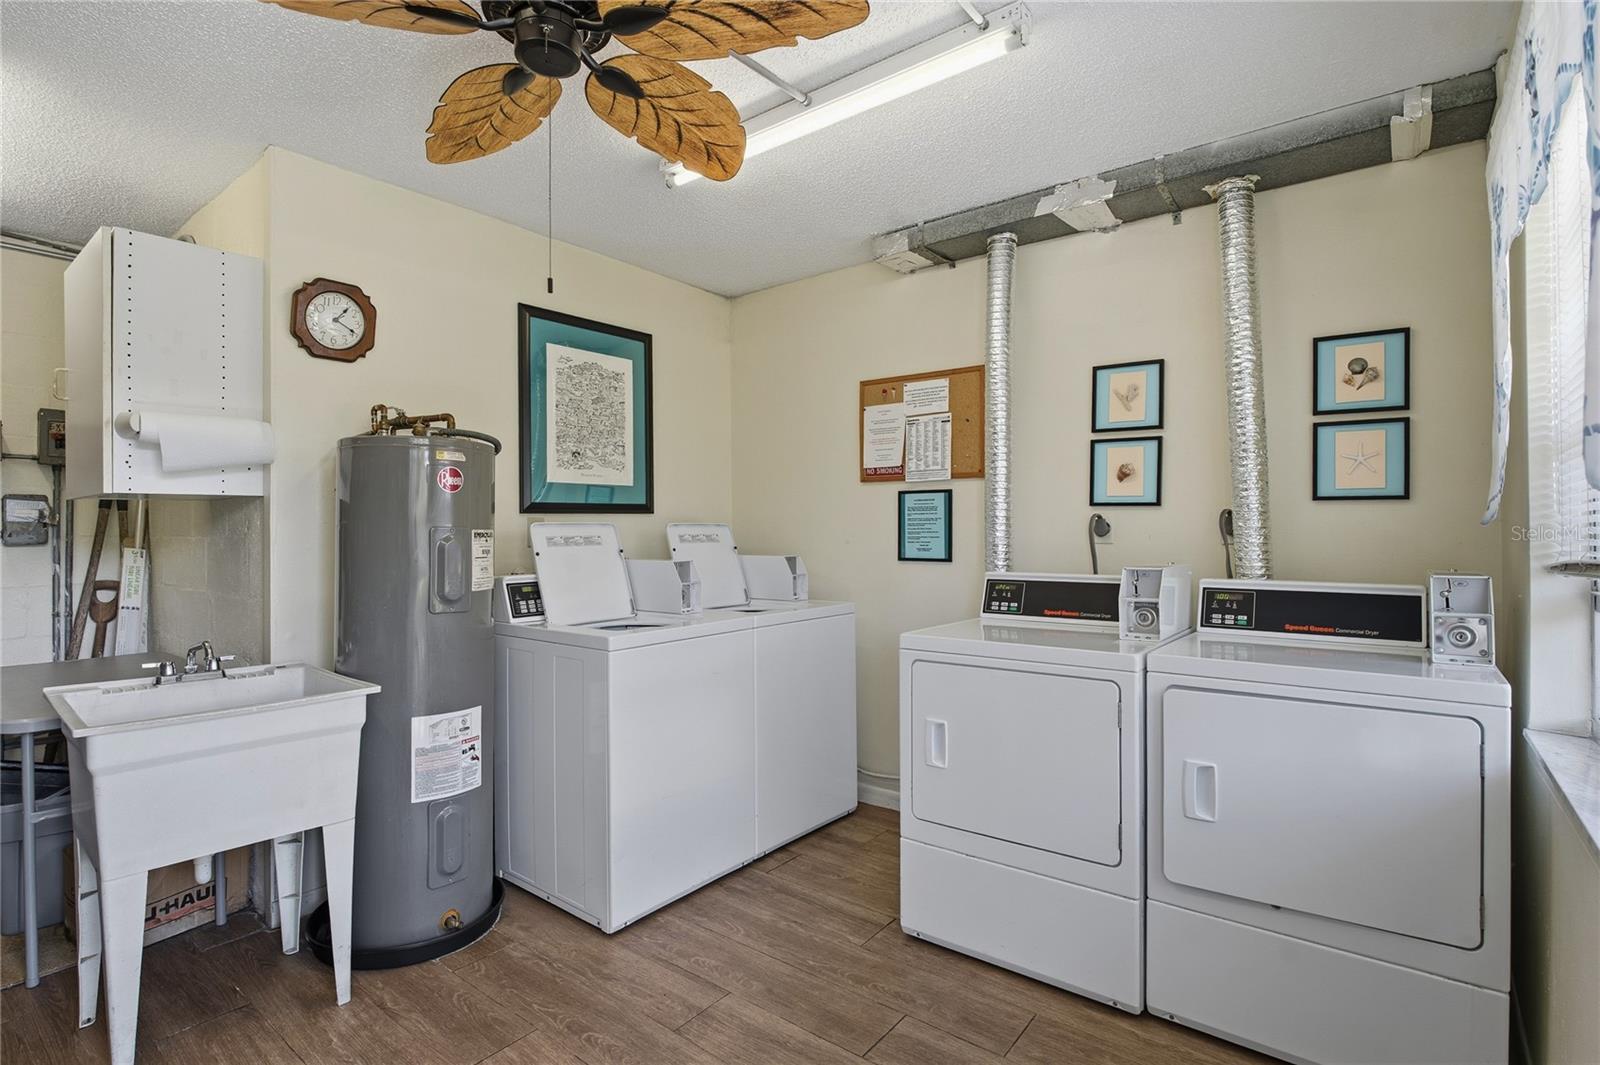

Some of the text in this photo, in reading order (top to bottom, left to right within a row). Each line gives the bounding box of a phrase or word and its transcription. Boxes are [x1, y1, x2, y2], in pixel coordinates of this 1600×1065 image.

[323, 297, 330, 306] 11
[333, 296, 342, 305] 12
[330, 335, 337, 345] 6
[876, 466, 903, 475] SMOKING
[1284, 624, 1309, 632] Speed
[1309, 625, 1335, 633] Queen
